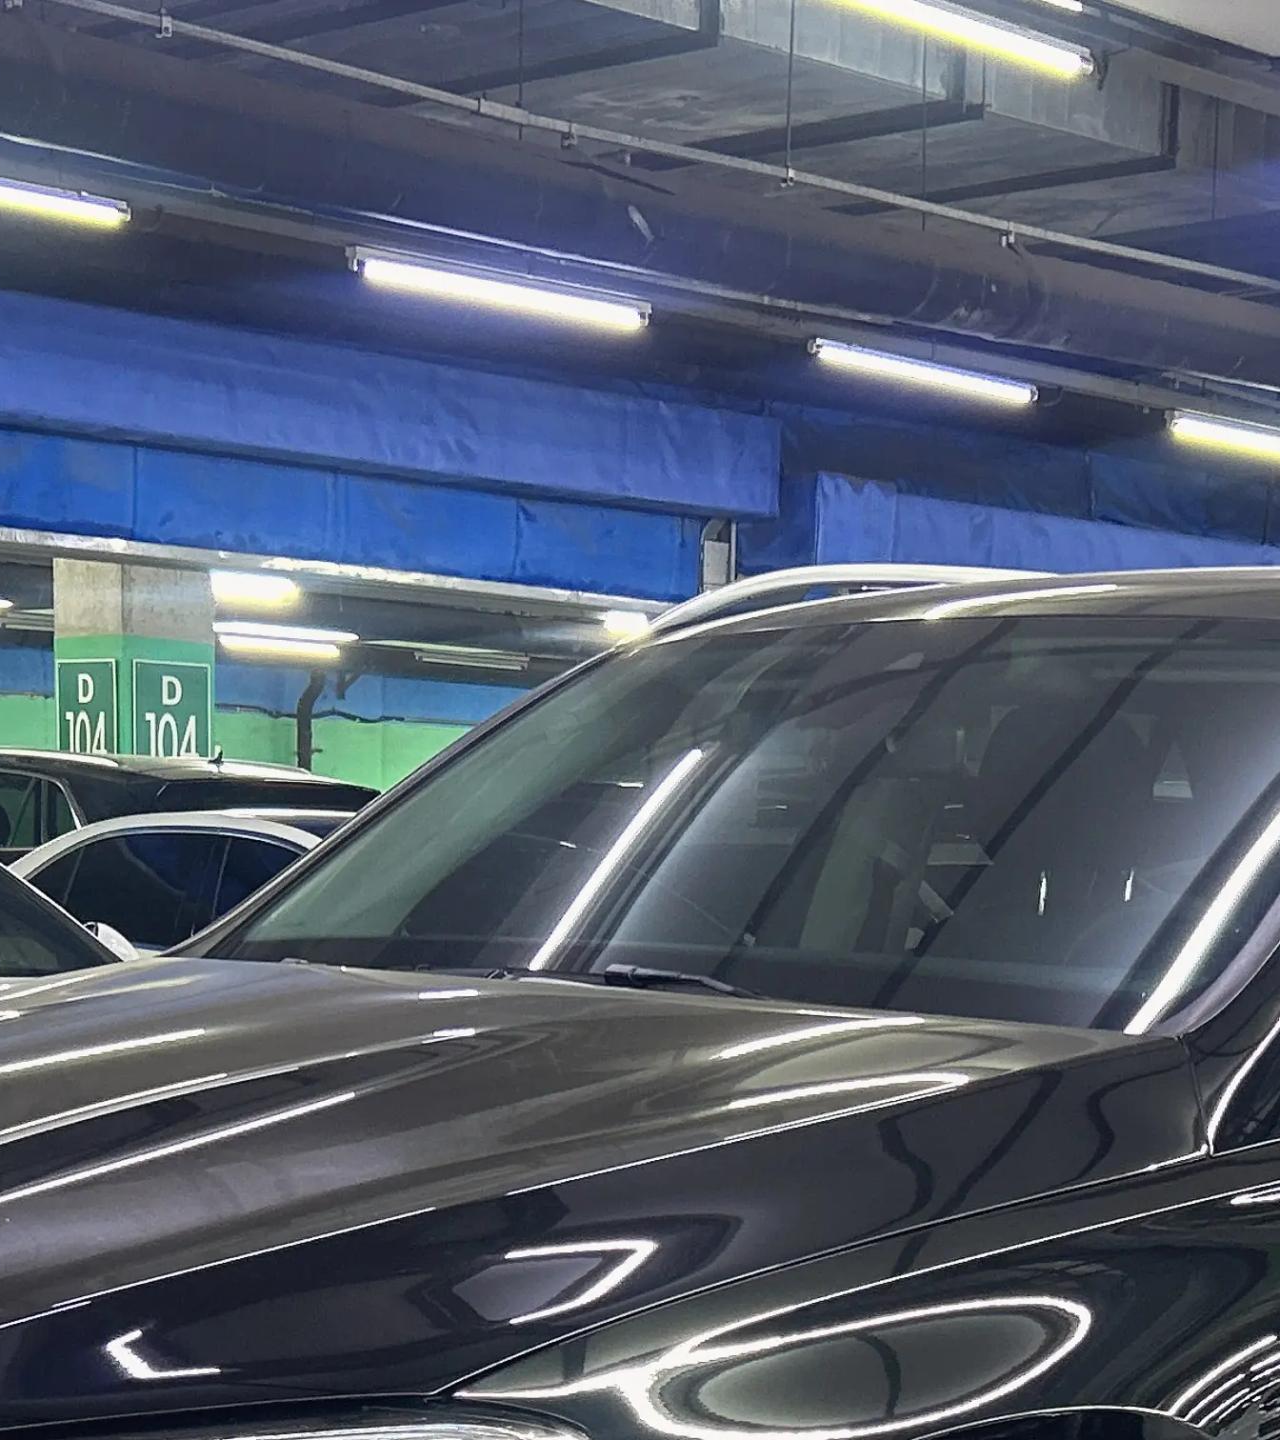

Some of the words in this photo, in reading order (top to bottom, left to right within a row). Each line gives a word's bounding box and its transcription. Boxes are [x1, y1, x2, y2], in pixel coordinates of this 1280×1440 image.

[77, 673, 95, 704] D
[161, 675, 183, 706] D
[65, 711, 107, 754] 104
[145, 712, 200, 757] 104
